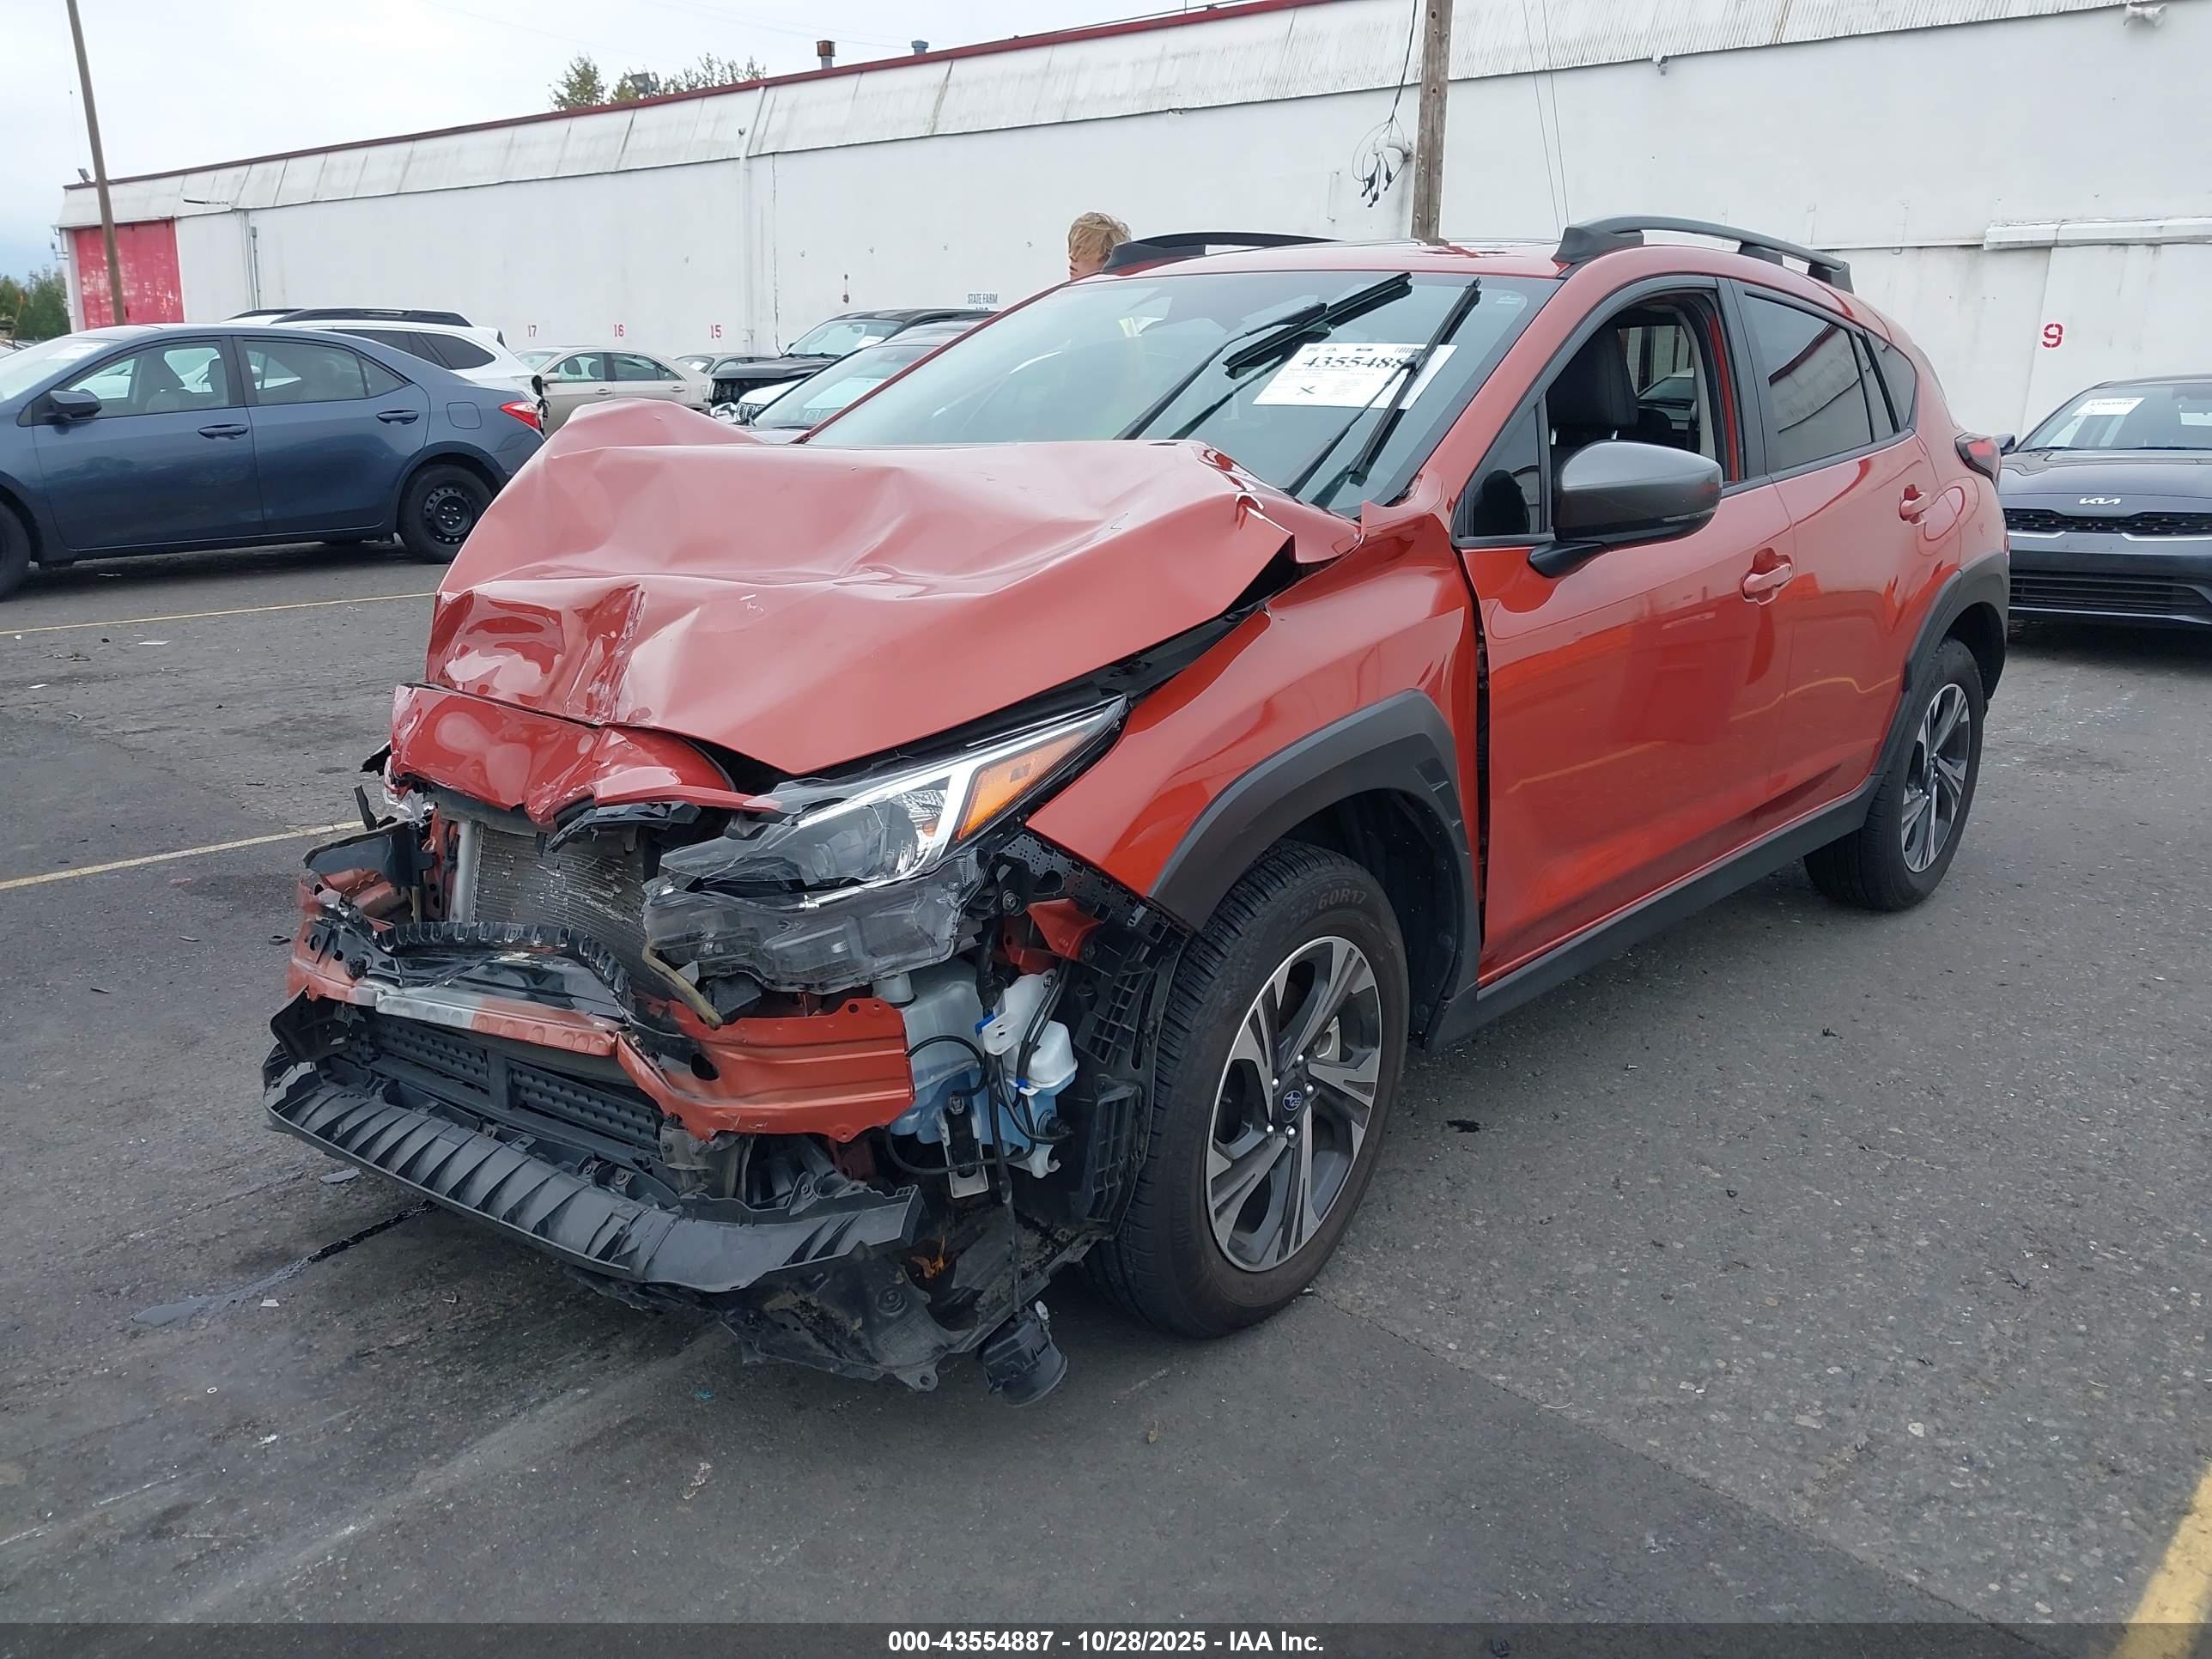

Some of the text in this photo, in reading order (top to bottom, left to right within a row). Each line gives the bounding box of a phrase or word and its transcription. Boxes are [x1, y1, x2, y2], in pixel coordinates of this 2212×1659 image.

[528, 325, 538, 337] 17
[614, 324, 625, 337] 16
[710, 325, 722, 339] 15
[2042, 323, 2063, 349] 9
